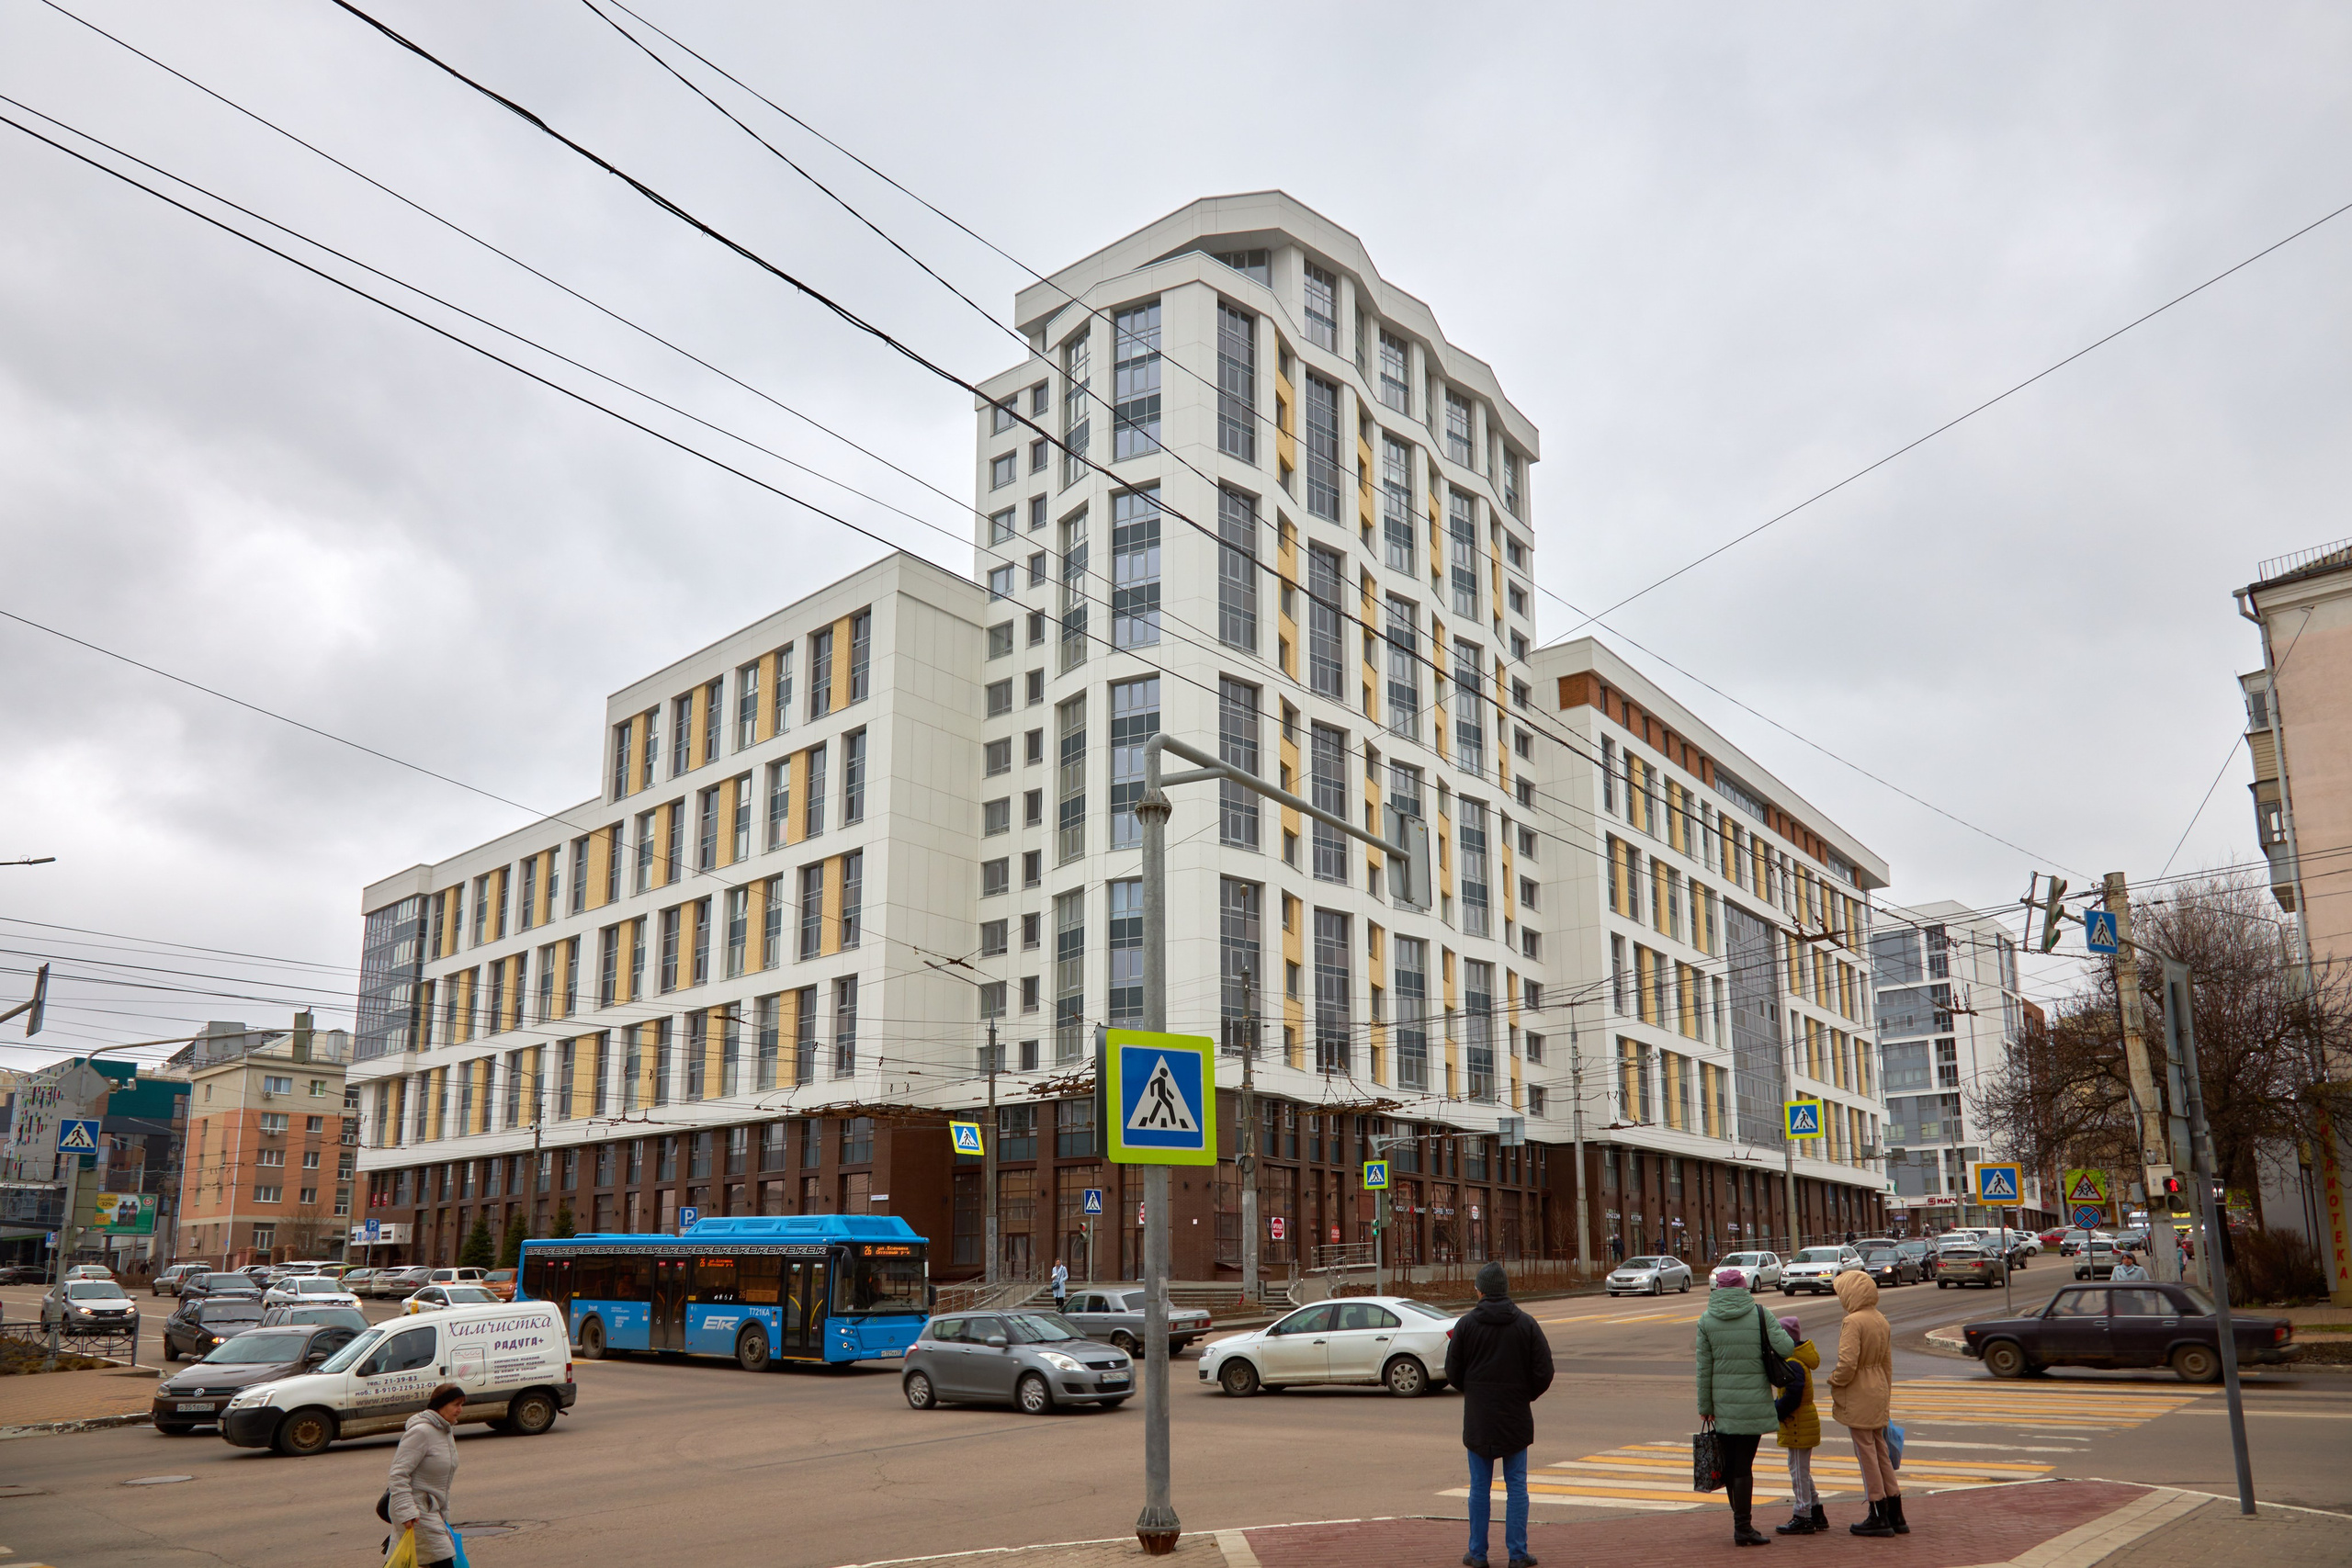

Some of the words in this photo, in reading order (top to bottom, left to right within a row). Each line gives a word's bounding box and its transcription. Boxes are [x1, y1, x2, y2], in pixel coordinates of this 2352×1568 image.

[865, 1246, 872, 1256] 26
[738, 1291, 746, 1299] 26
[448, 1316, 553, 1337] Химчистка
[494, 1337, 544, 1350] РАДУГА+
[384, 1375, 418, 1385] 21-39-83
[356, 1389, 372, 1397] моб.:
[375, 1382, 437, 1394] 8-910-229-32-03
[356, 1392, 432, 1406] www.raduga-31.r
